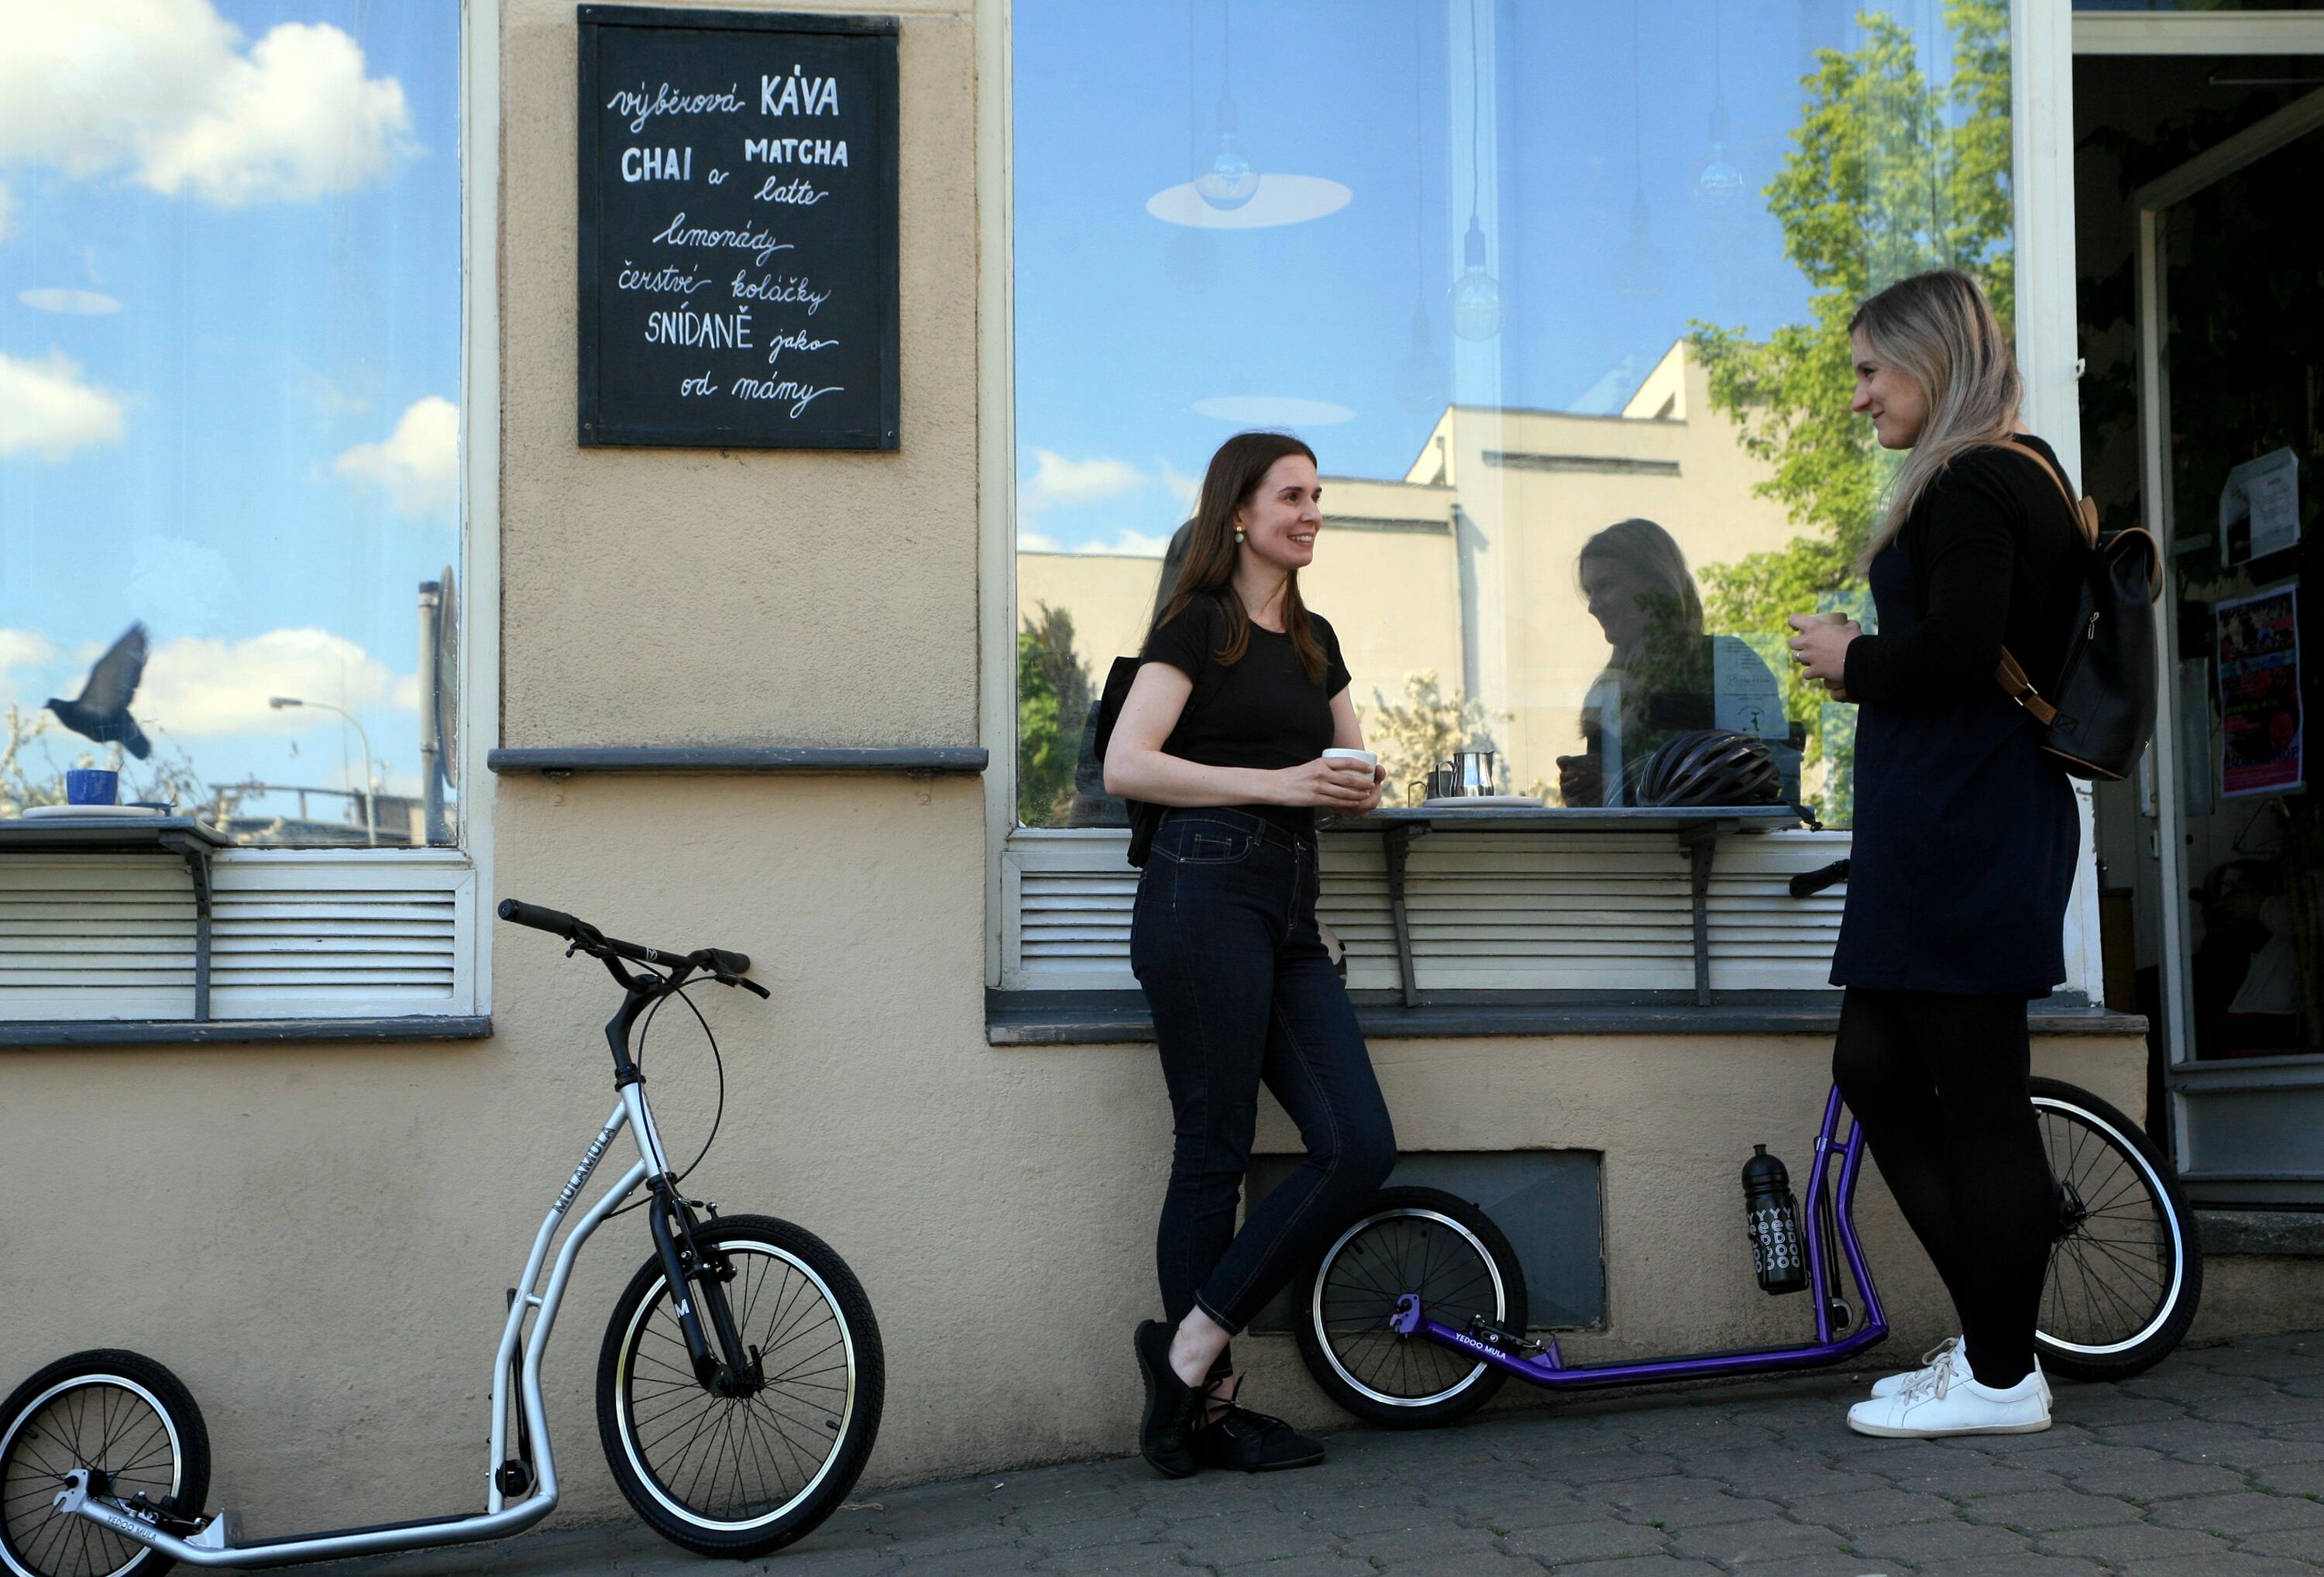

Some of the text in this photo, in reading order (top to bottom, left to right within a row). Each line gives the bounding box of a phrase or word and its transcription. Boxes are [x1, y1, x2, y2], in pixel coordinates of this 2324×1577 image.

[607, 64, 839, 133] výběrová KÁVA
[621, 139, 848, 185] CHAI a MATCHA
[754, 175, 829, 205] latte
[652, 212, 794, 266] limonády
[619, 260, 831, 315] čerstvé koláčky
[645, 301, 839, 364] SNÍDANĚ jako
[681, 371, 844, 419] od mámy
[1456, 1332, 1506, 1359] YEDOO MULA
[107, 1514, 156, 1541] YEDOO MULA
